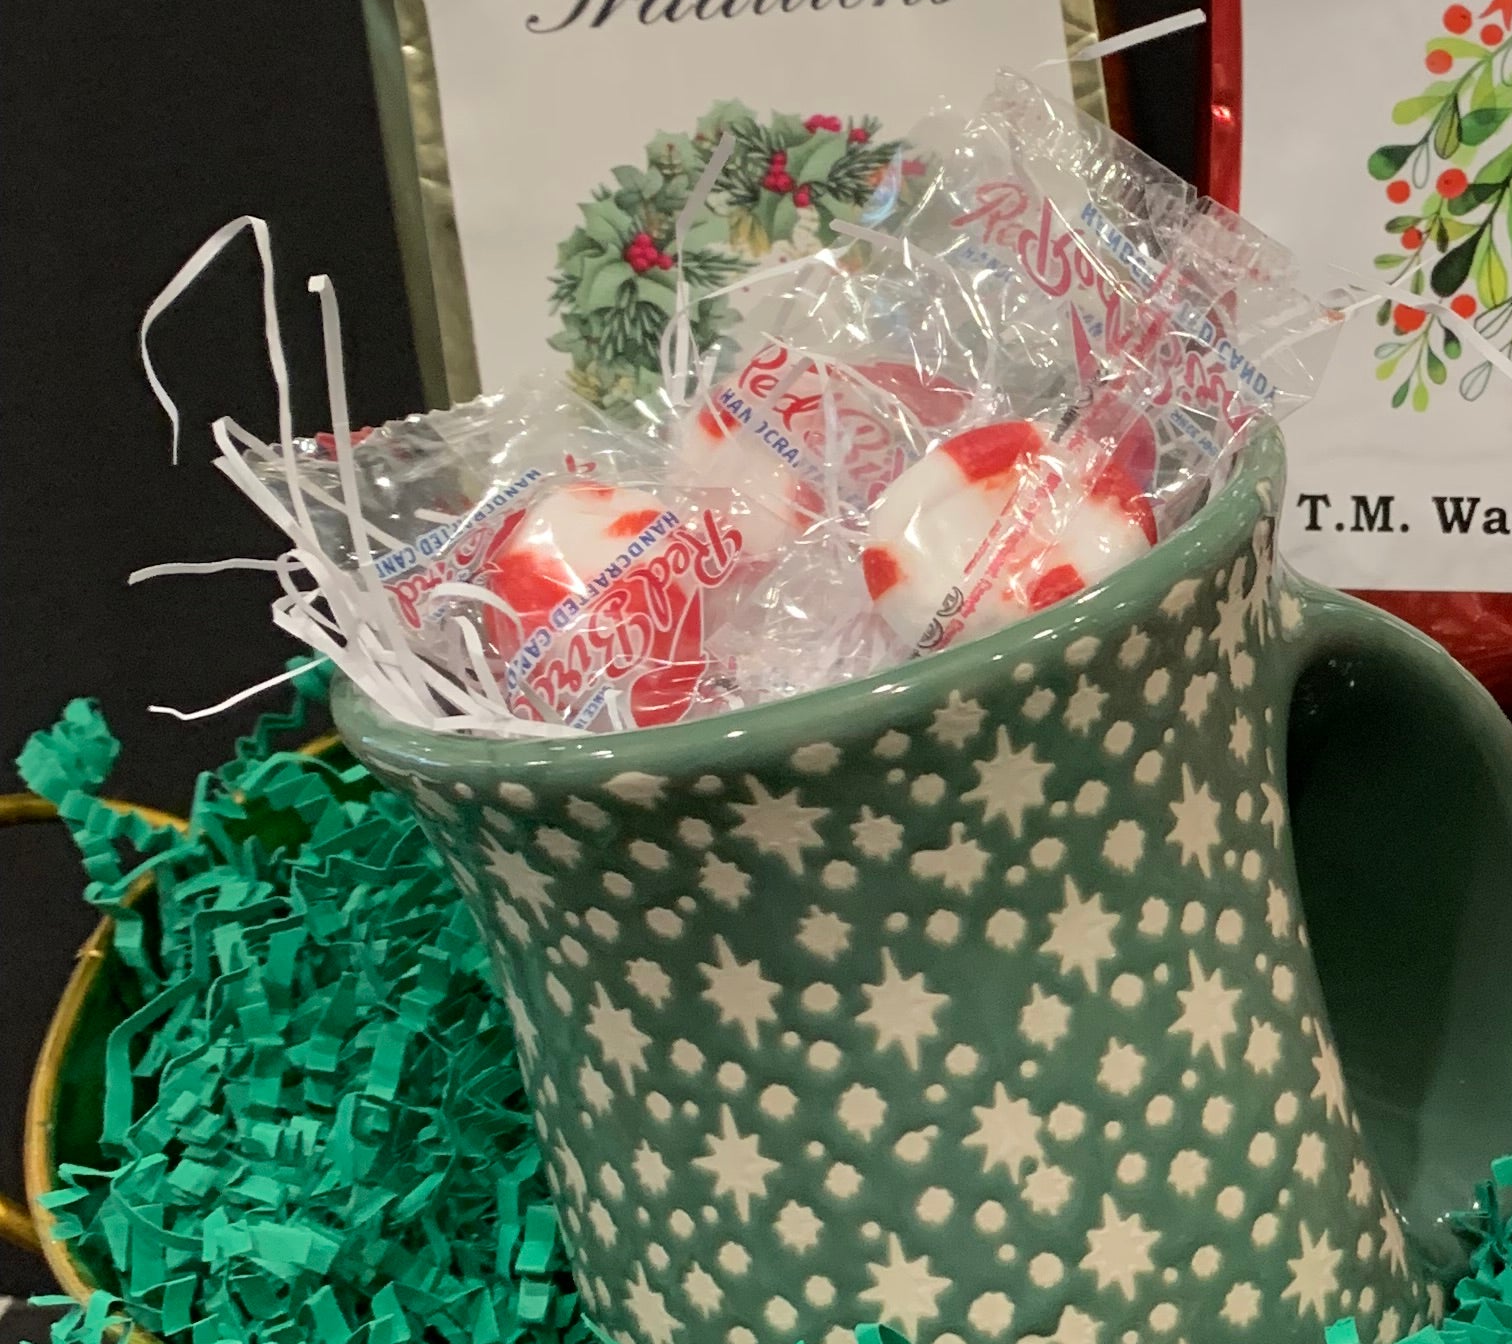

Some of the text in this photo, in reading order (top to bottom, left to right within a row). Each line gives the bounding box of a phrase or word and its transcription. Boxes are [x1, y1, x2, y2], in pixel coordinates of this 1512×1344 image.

[1297, 493, 1411, 534] T.M.
[376, 546, 417, 578] CAN
[507, 511, 680, 692] HANDCRAFTED CAND
[623, 509, 743, 632] Red
